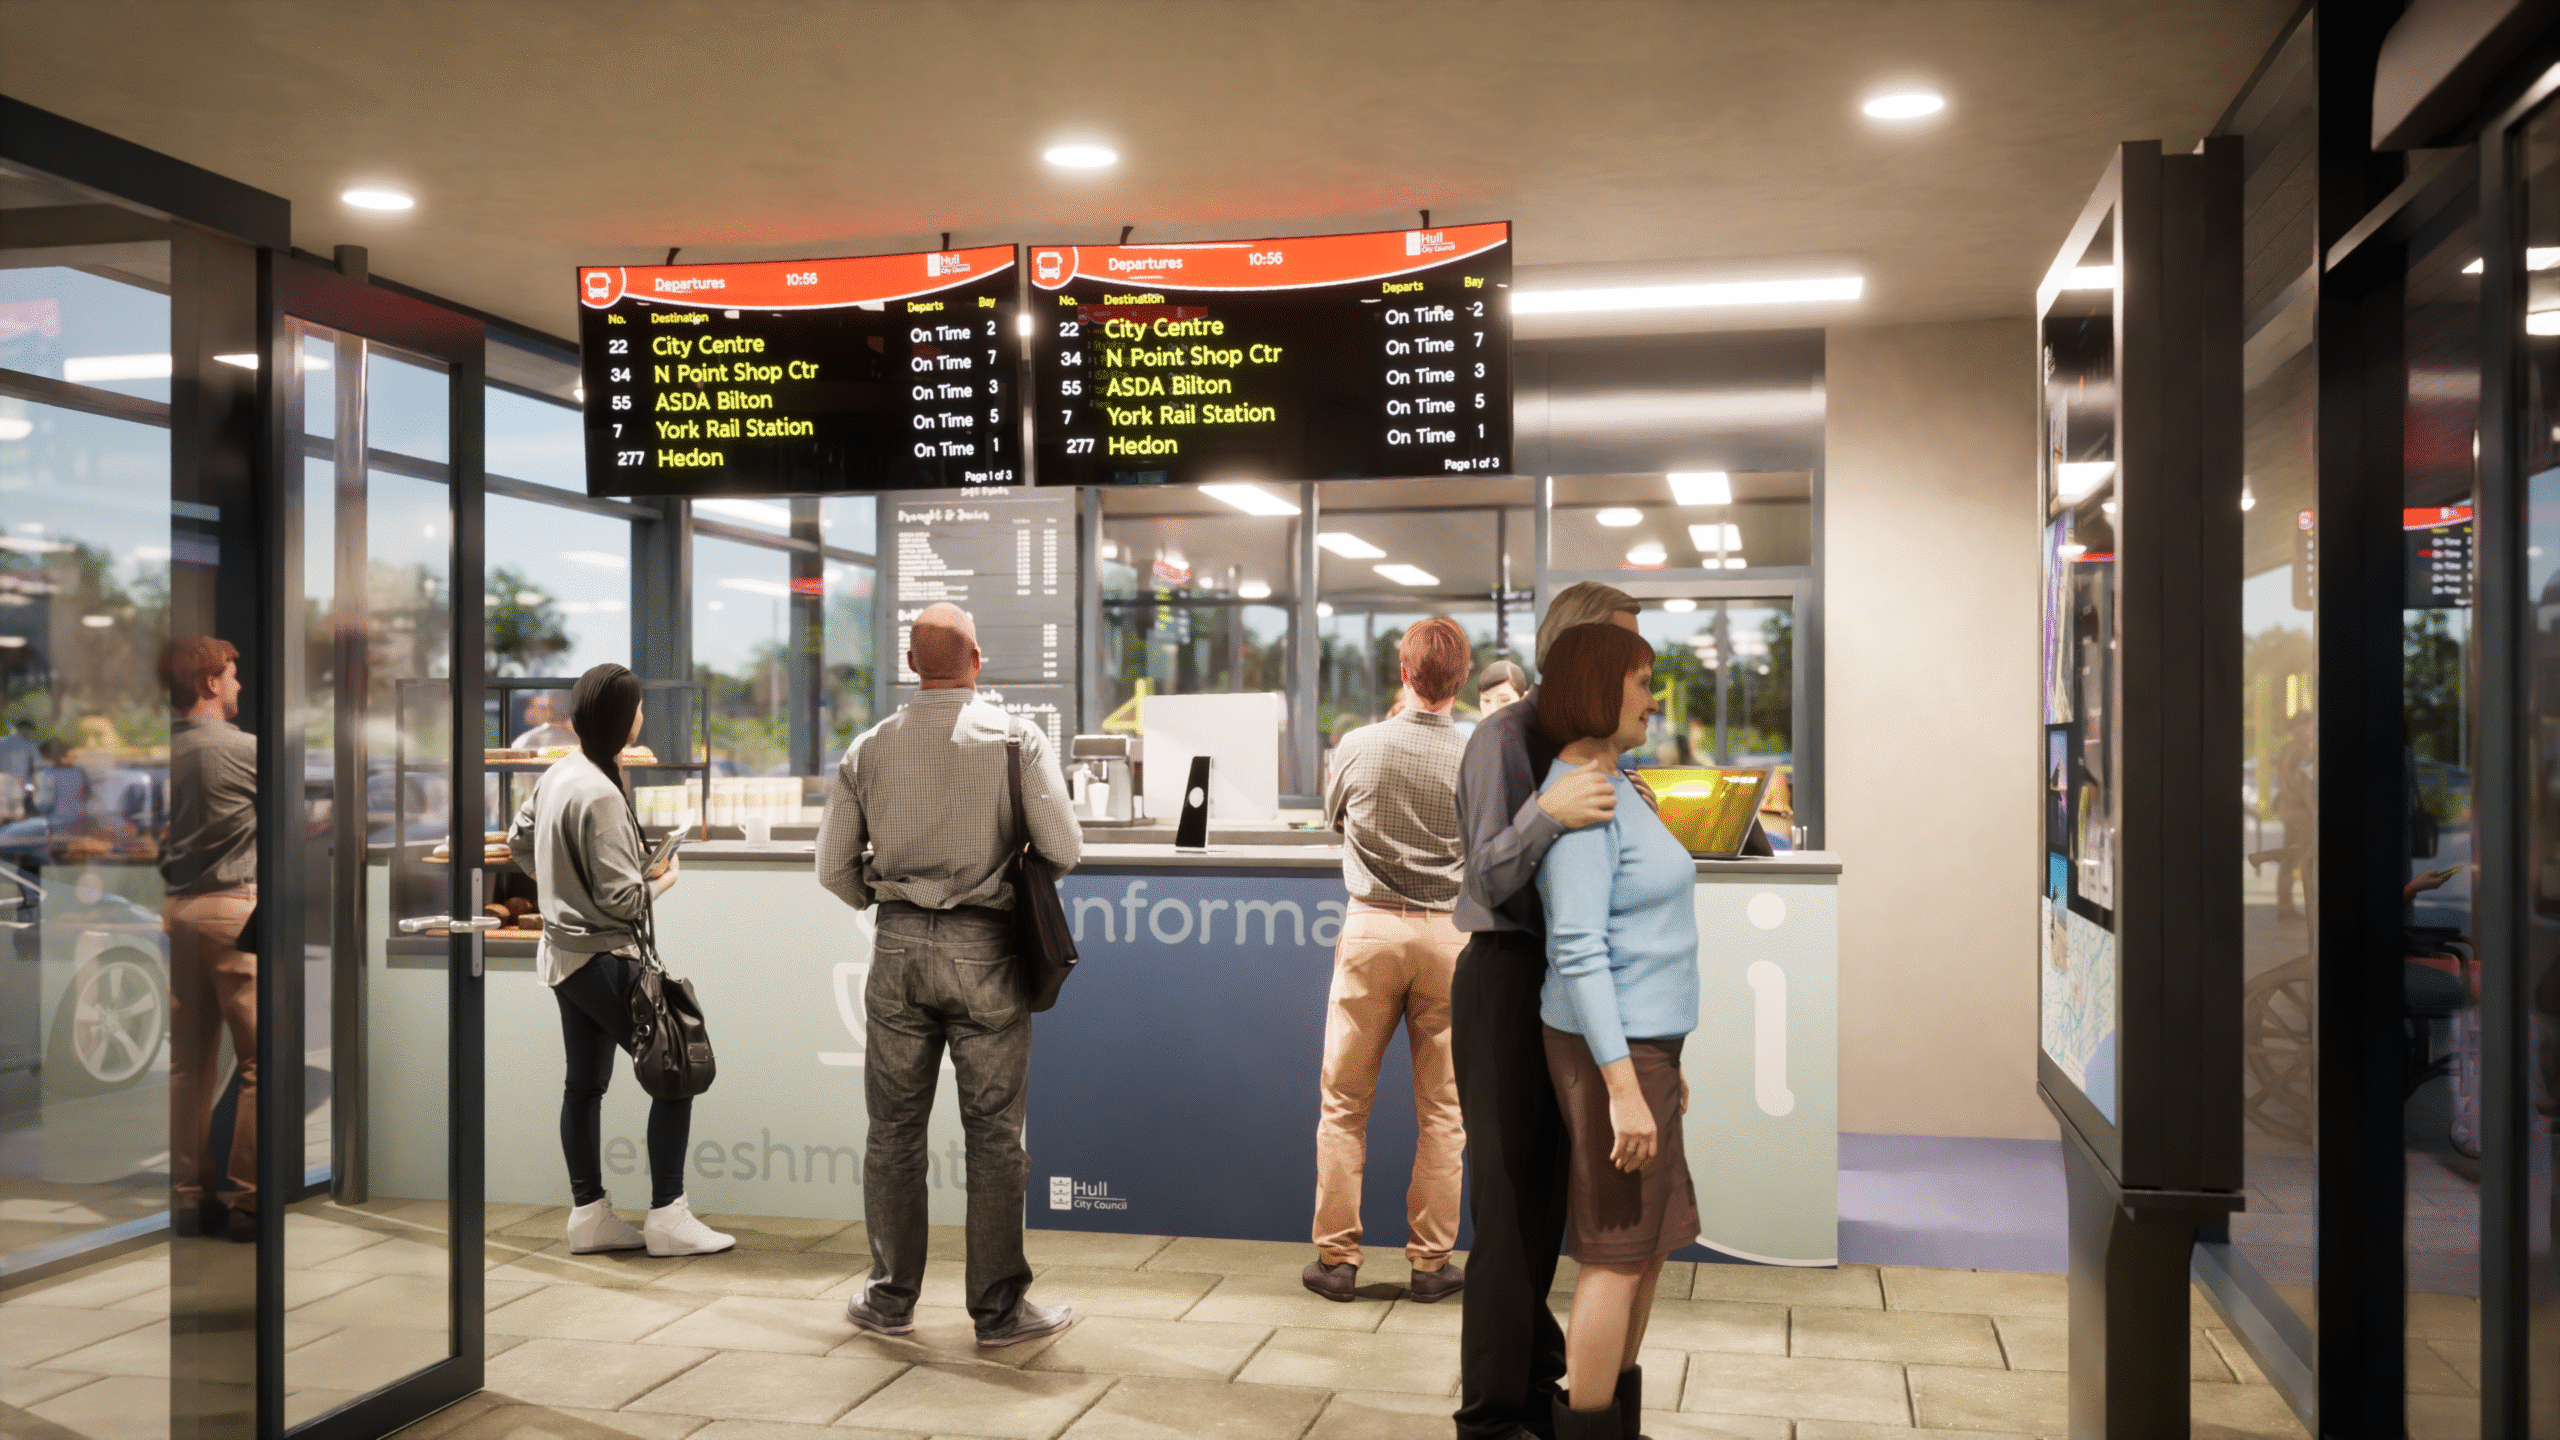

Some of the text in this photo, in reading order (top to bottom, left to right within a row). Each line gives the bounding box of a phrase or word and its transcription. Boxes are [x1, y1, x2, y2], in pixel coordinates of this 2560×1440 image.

[1422, 231, 1443, 244] Hull
[941, 254, 959, 265] Hull
[1109, 256, 1183, 273] Departures
[1249, 252, 1283, 266] 10:56
[655, 275, 725, 292] Departures
[786, 272, 817, 286] 10:56
[1059, 275, 1483, 306] No. Destination Departs Bay
[608, 297, 995, 324] No. Destination Departs Bay
[1059, 301, 1483, 341] 22 City Centre On Time 2
[609, 320, 996, 358] 22 City Centre On Time 2
[1061, 332, 1483, 367] 34 N Point Shop Ctr On Time 7
[611, 349, 996, 383] 34 N Point Shop Ctr On Time 7
[1061, 362, 1485, 396] 55 ASDA Bilton On Time 3
[612, 379, 998, 411] 55 ASDA Bilton On Time 3
[613, 408, 998, 439] 7 York Rail Station On Time 5
[1063, 393, 1485, 426] 7 York Rail Station On Time 5
[618, 437, 999, 467] 277 Hedon On Time 1
[1067, 423, 1485, 455] 277 Hedon On Time 1
[965, 469, 1012, 482] Page 1 of 3
[1445, 458, 1499, 471] Page 1 of 3
[1074, 1181, 1107, 1196] Hull
[1074, 1200, 1127, 1210] City Council
